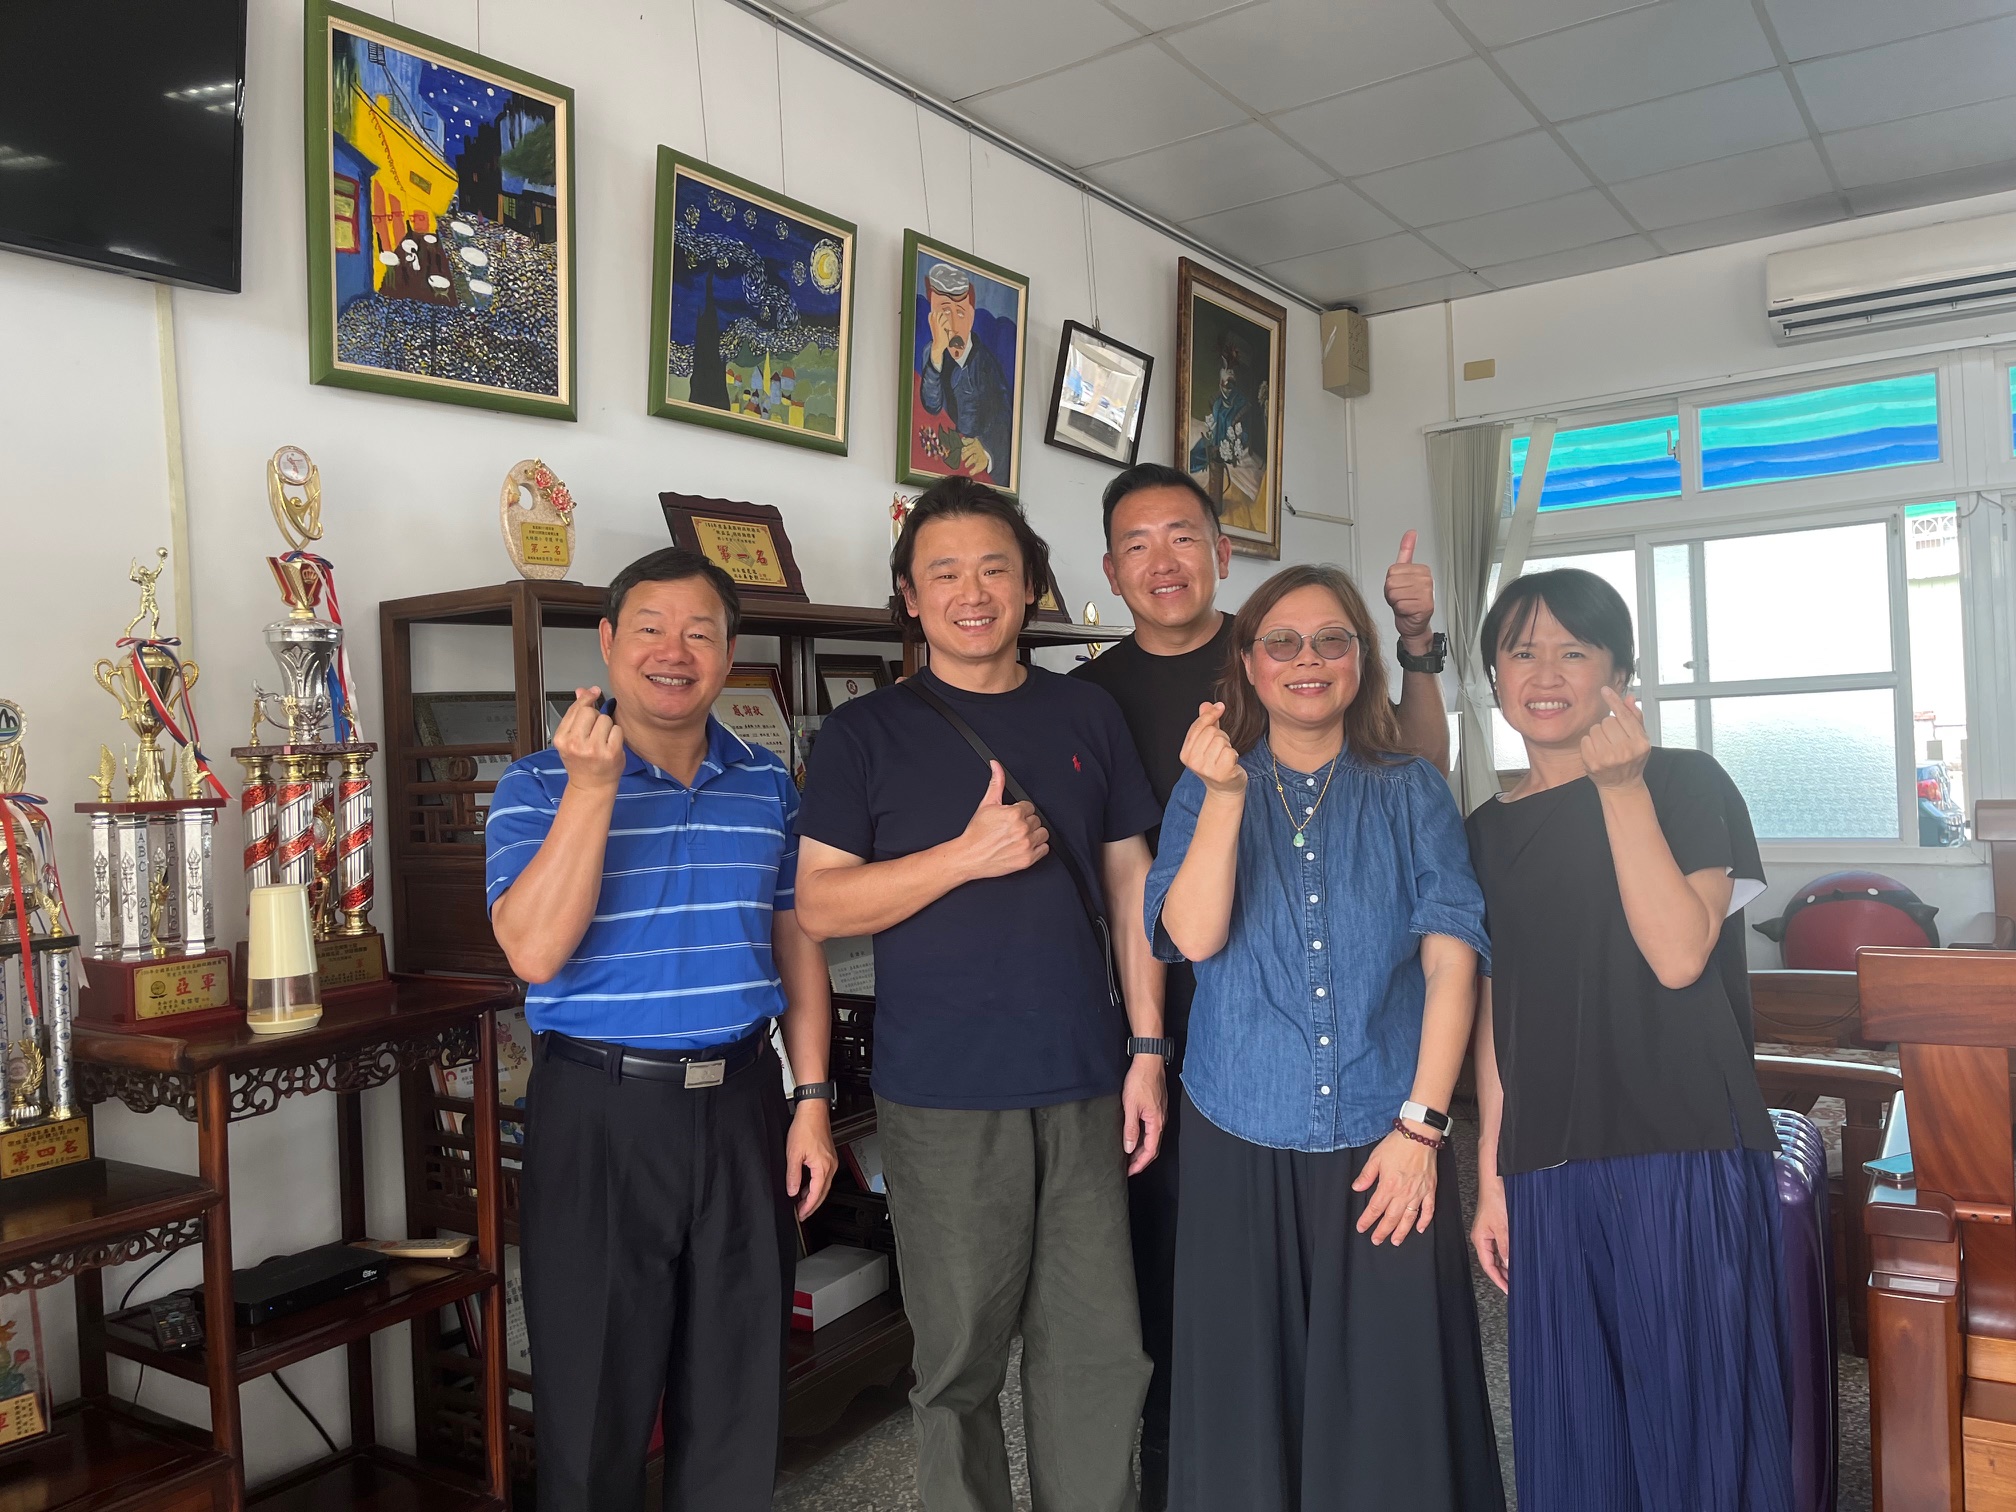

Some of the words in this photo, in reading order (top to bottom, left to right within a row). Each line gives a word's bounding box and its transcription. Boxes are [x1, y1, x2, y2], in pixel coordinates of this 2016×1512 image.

[531, 543, 561, 555] 第二名
[717, 545, 768, 567] 第一名
[732, 704, 764, 717] 感謝狀
[176, 973, 217, 997] 亞軍
[12, 1140, 79, 1166] 第四名
